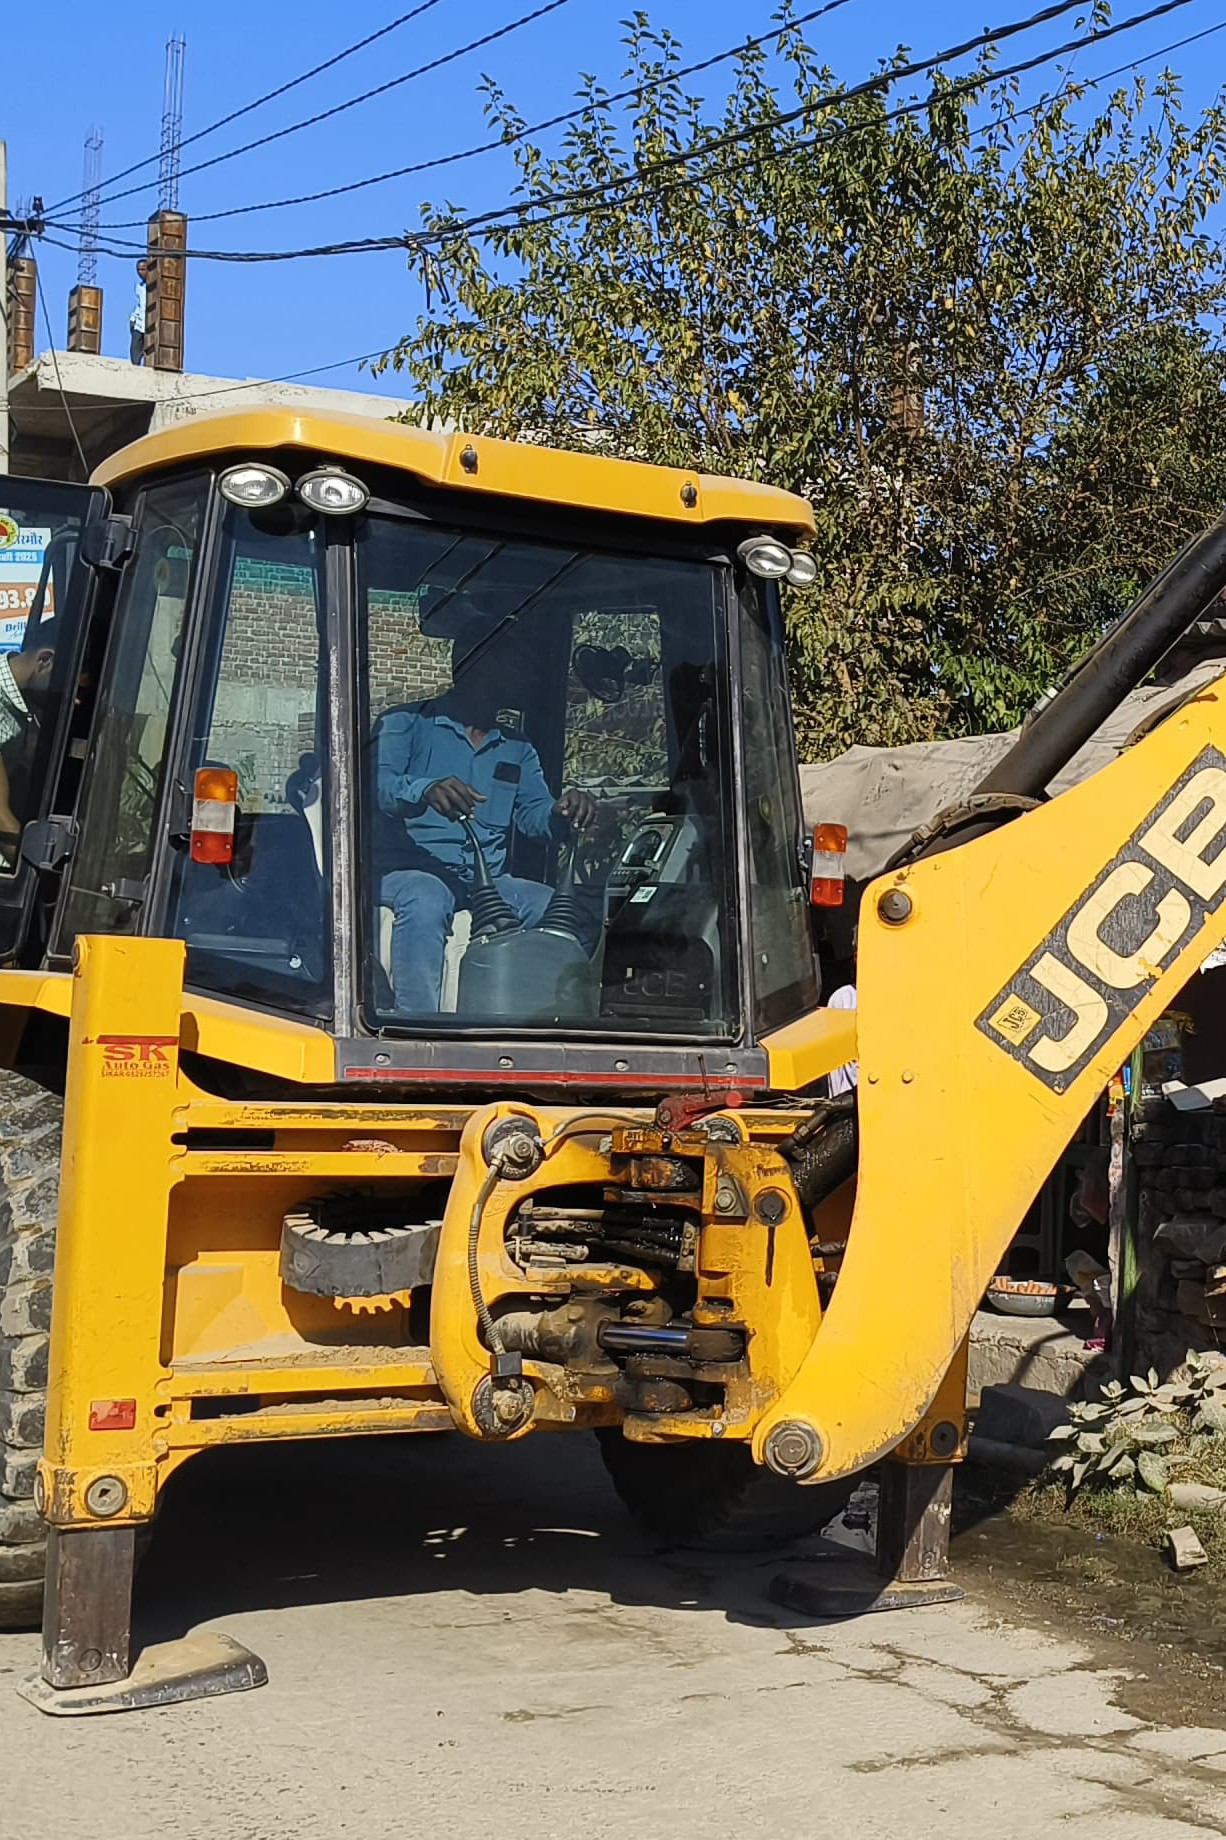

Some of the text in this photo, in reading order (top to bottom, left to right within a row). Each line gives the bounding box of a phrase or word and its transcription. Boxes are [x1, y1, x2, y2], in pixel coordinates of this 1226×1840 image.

[1003, 1008, 1026, 1029] JCB
[105, 1060, 170, 1070] Auto Gas
